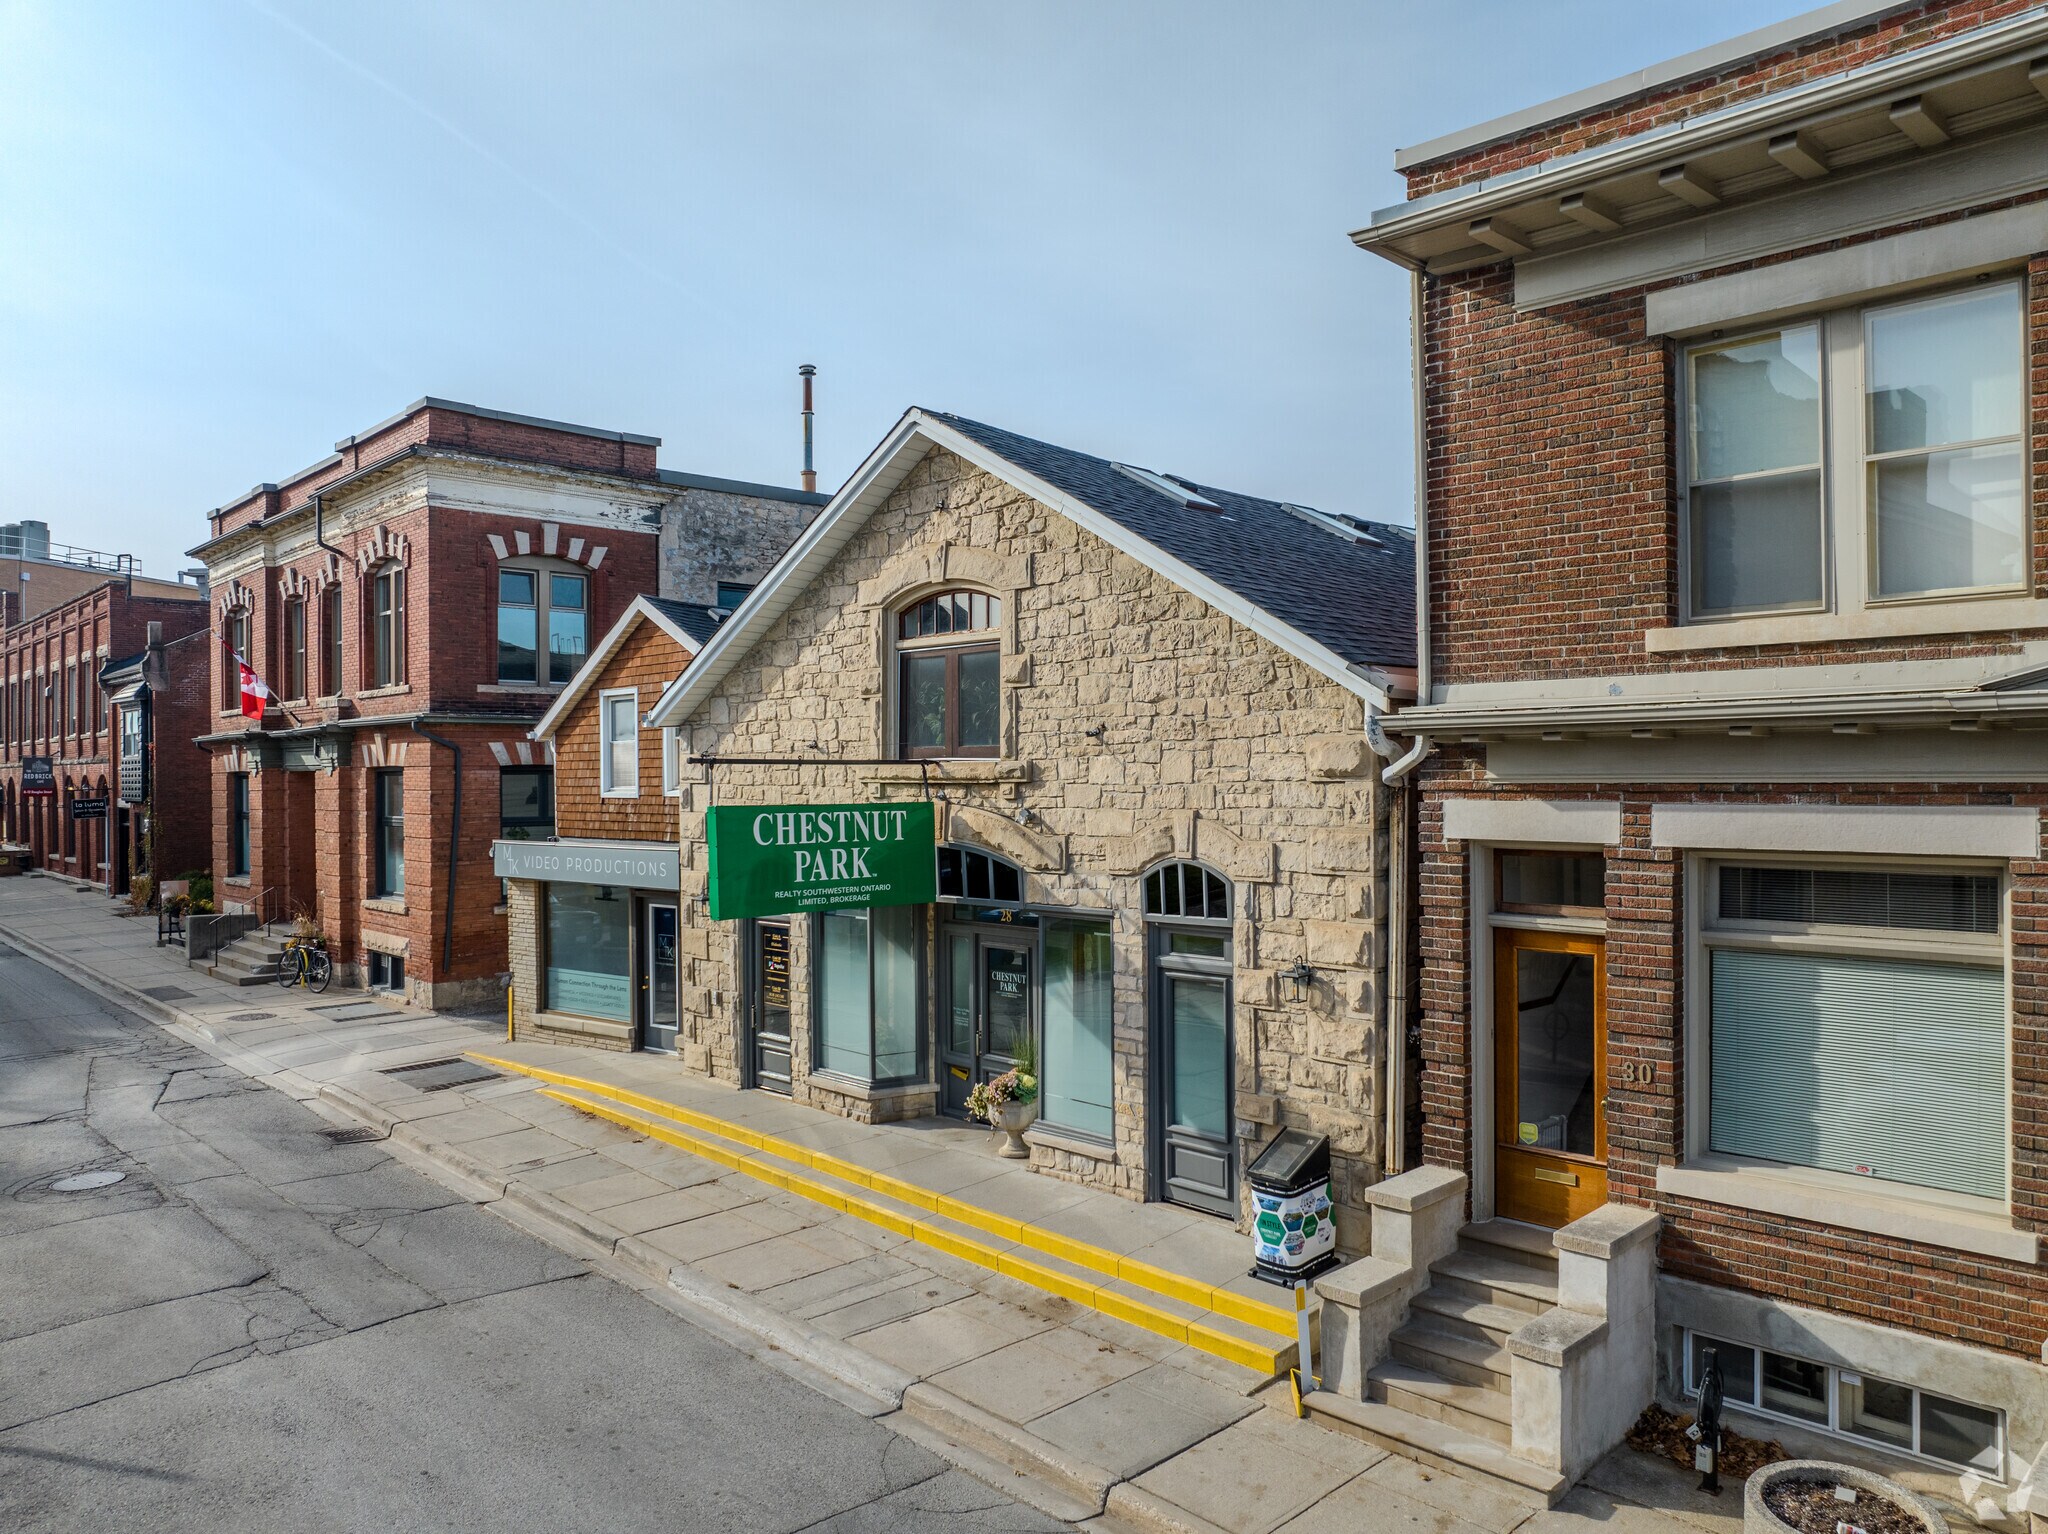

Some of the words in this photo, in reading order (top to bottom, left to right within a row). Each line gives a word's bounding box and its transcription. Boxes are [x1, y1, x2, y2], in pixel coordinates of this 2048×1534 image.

[752, 810, 907, 846] CHESTNUT
[523, 855, 560, 870] VIDEO
[566, 857, 667, 877] PRODUCTIONS
[793, 847, 872, 883] PARK
[774, 890, 801, 899] REALTY
[802, 886, 860, 897] SOUTHWESTERN
[860, 883, 891, 892] ONTARIO
[798, 897, 829, 906] LIMITED,
[830, 894, 870, 904] BROKERAGE
[1000, 908, 1012, 922] 28
[568, 978, 591, 987] Connection
[591, 981, 609, 991] Through
[991, 970, 1027, 984] CHESTNUT
[1000, 981, 1018, 993] PARK
[1622, 1061, 1652, 1084] 30
